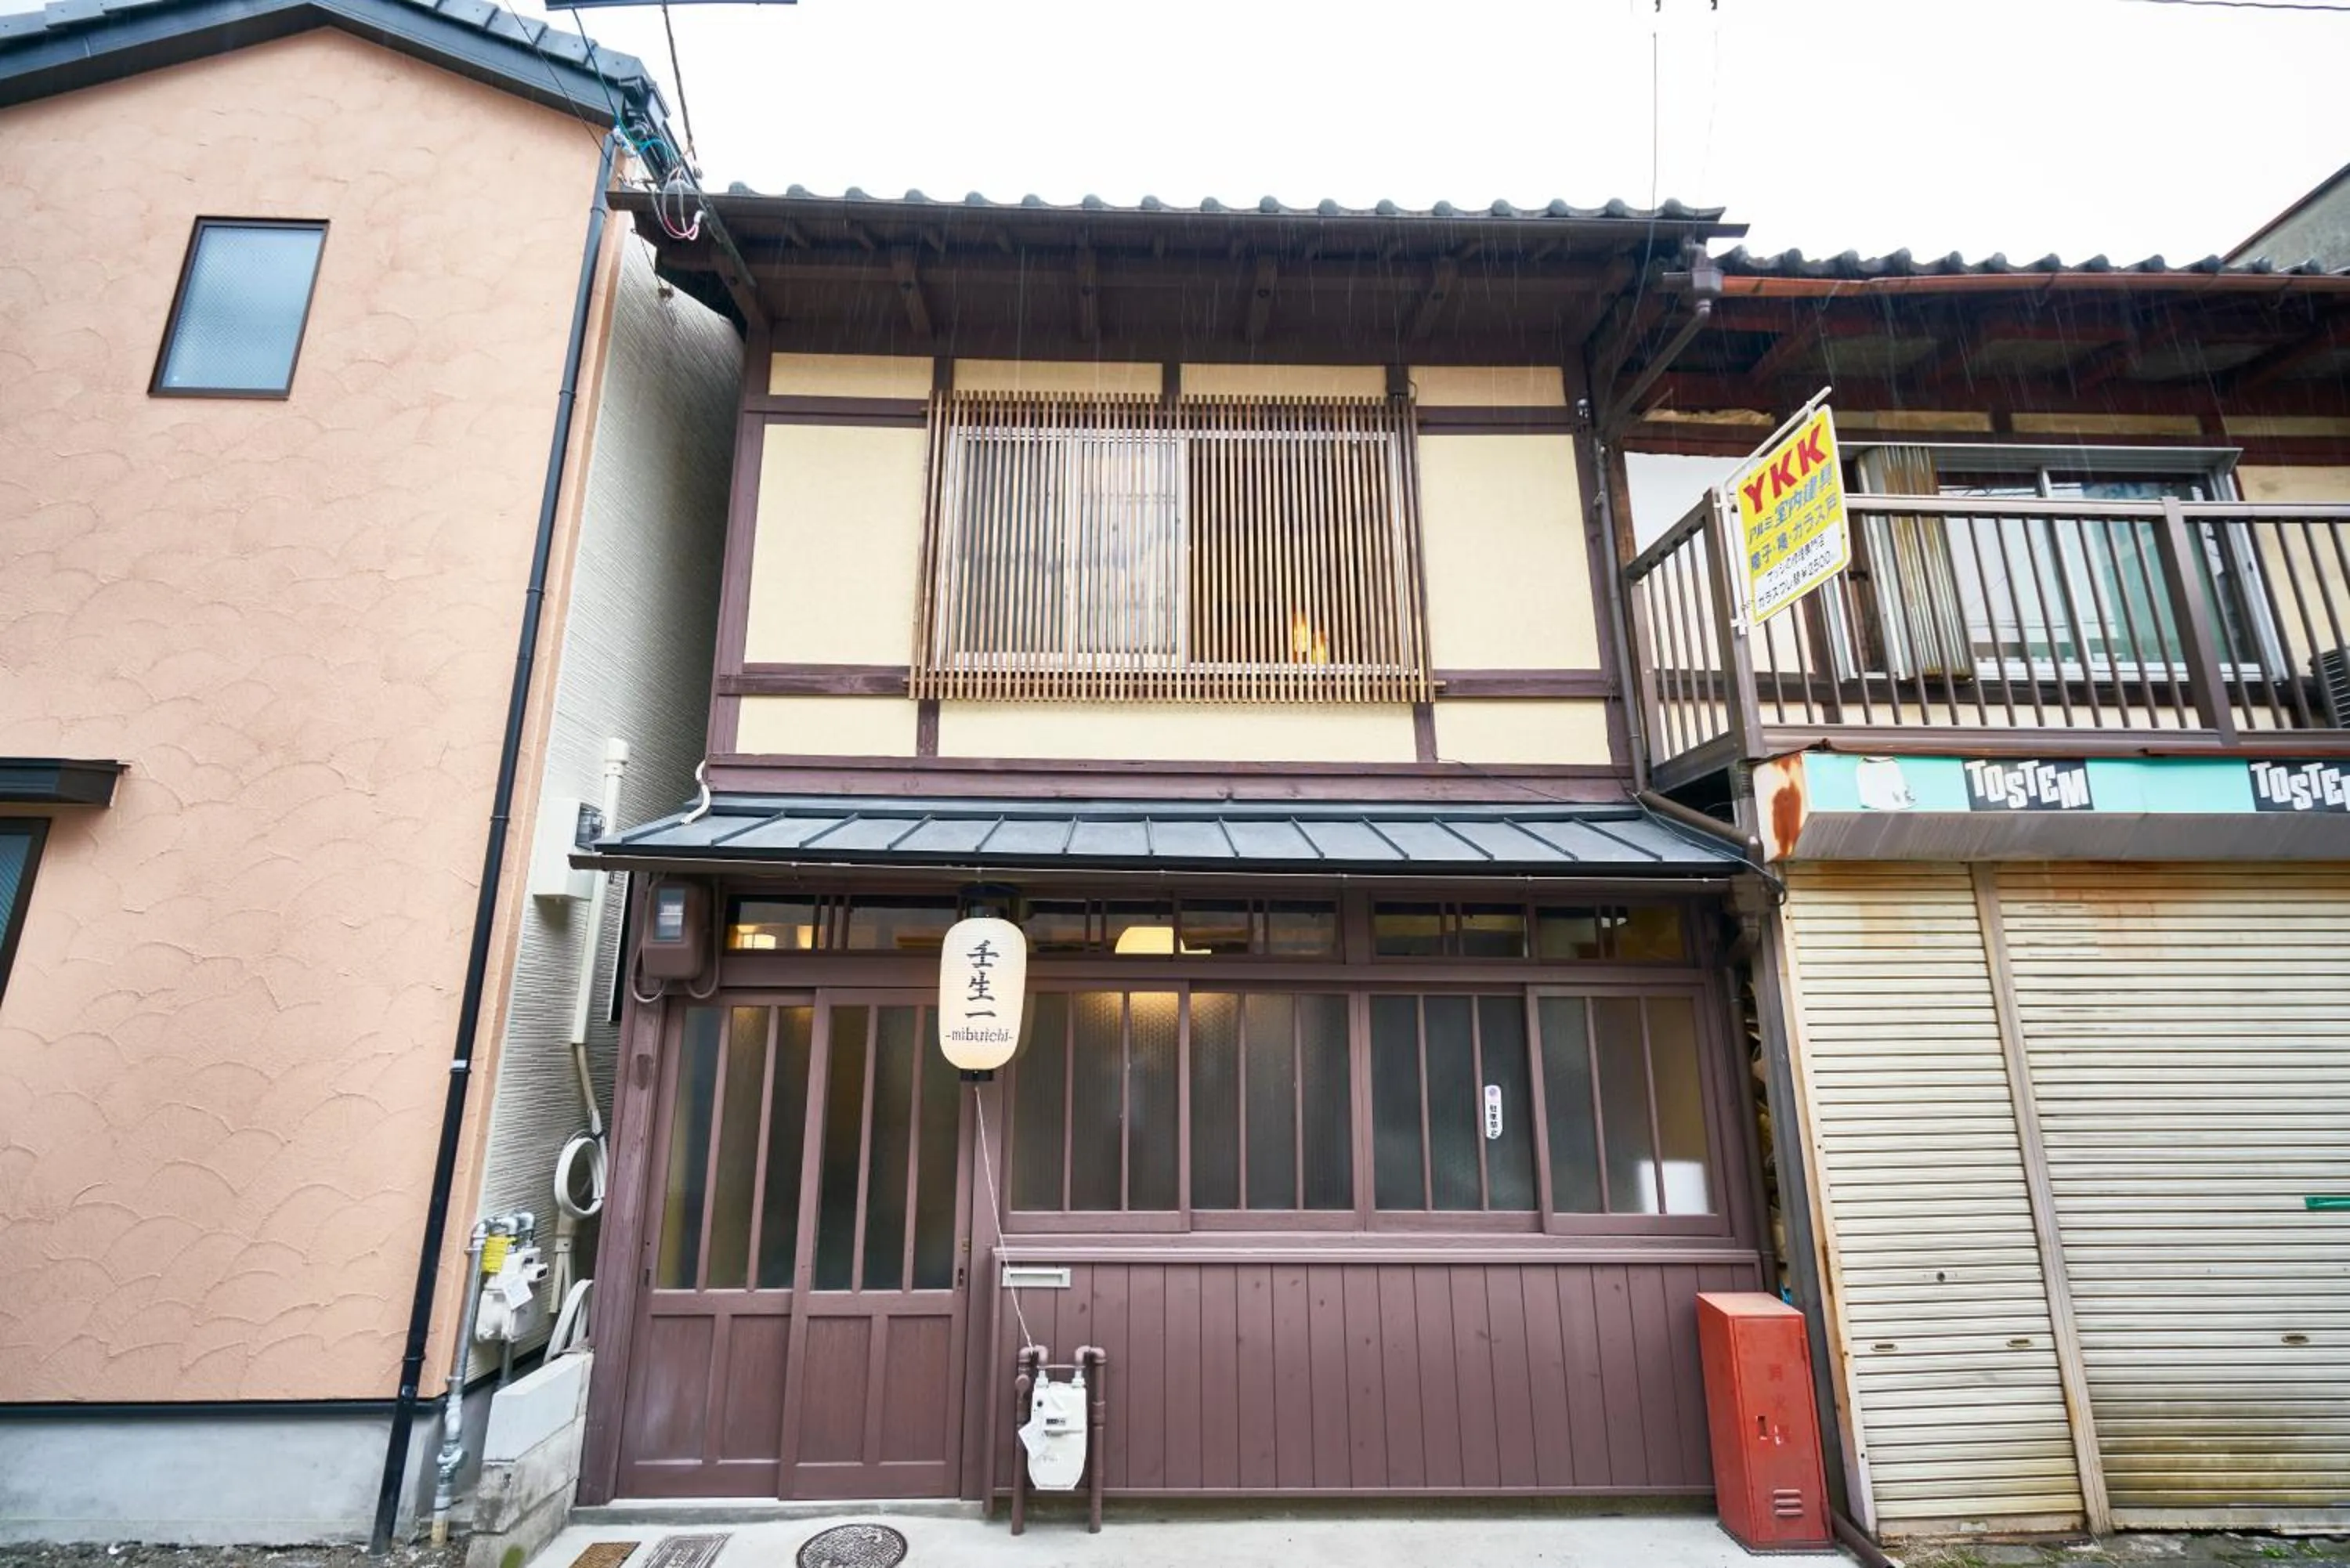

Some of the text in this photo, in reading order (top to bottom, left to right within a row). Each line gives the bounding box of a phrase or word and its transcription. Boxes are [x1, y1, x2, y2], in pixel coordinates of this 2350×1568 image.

[1743, 423, 1827, 515] YKK
[1964, 758, 2091, 810] TOSTEM
[965, 940, 1000, 1018] 壬生一
